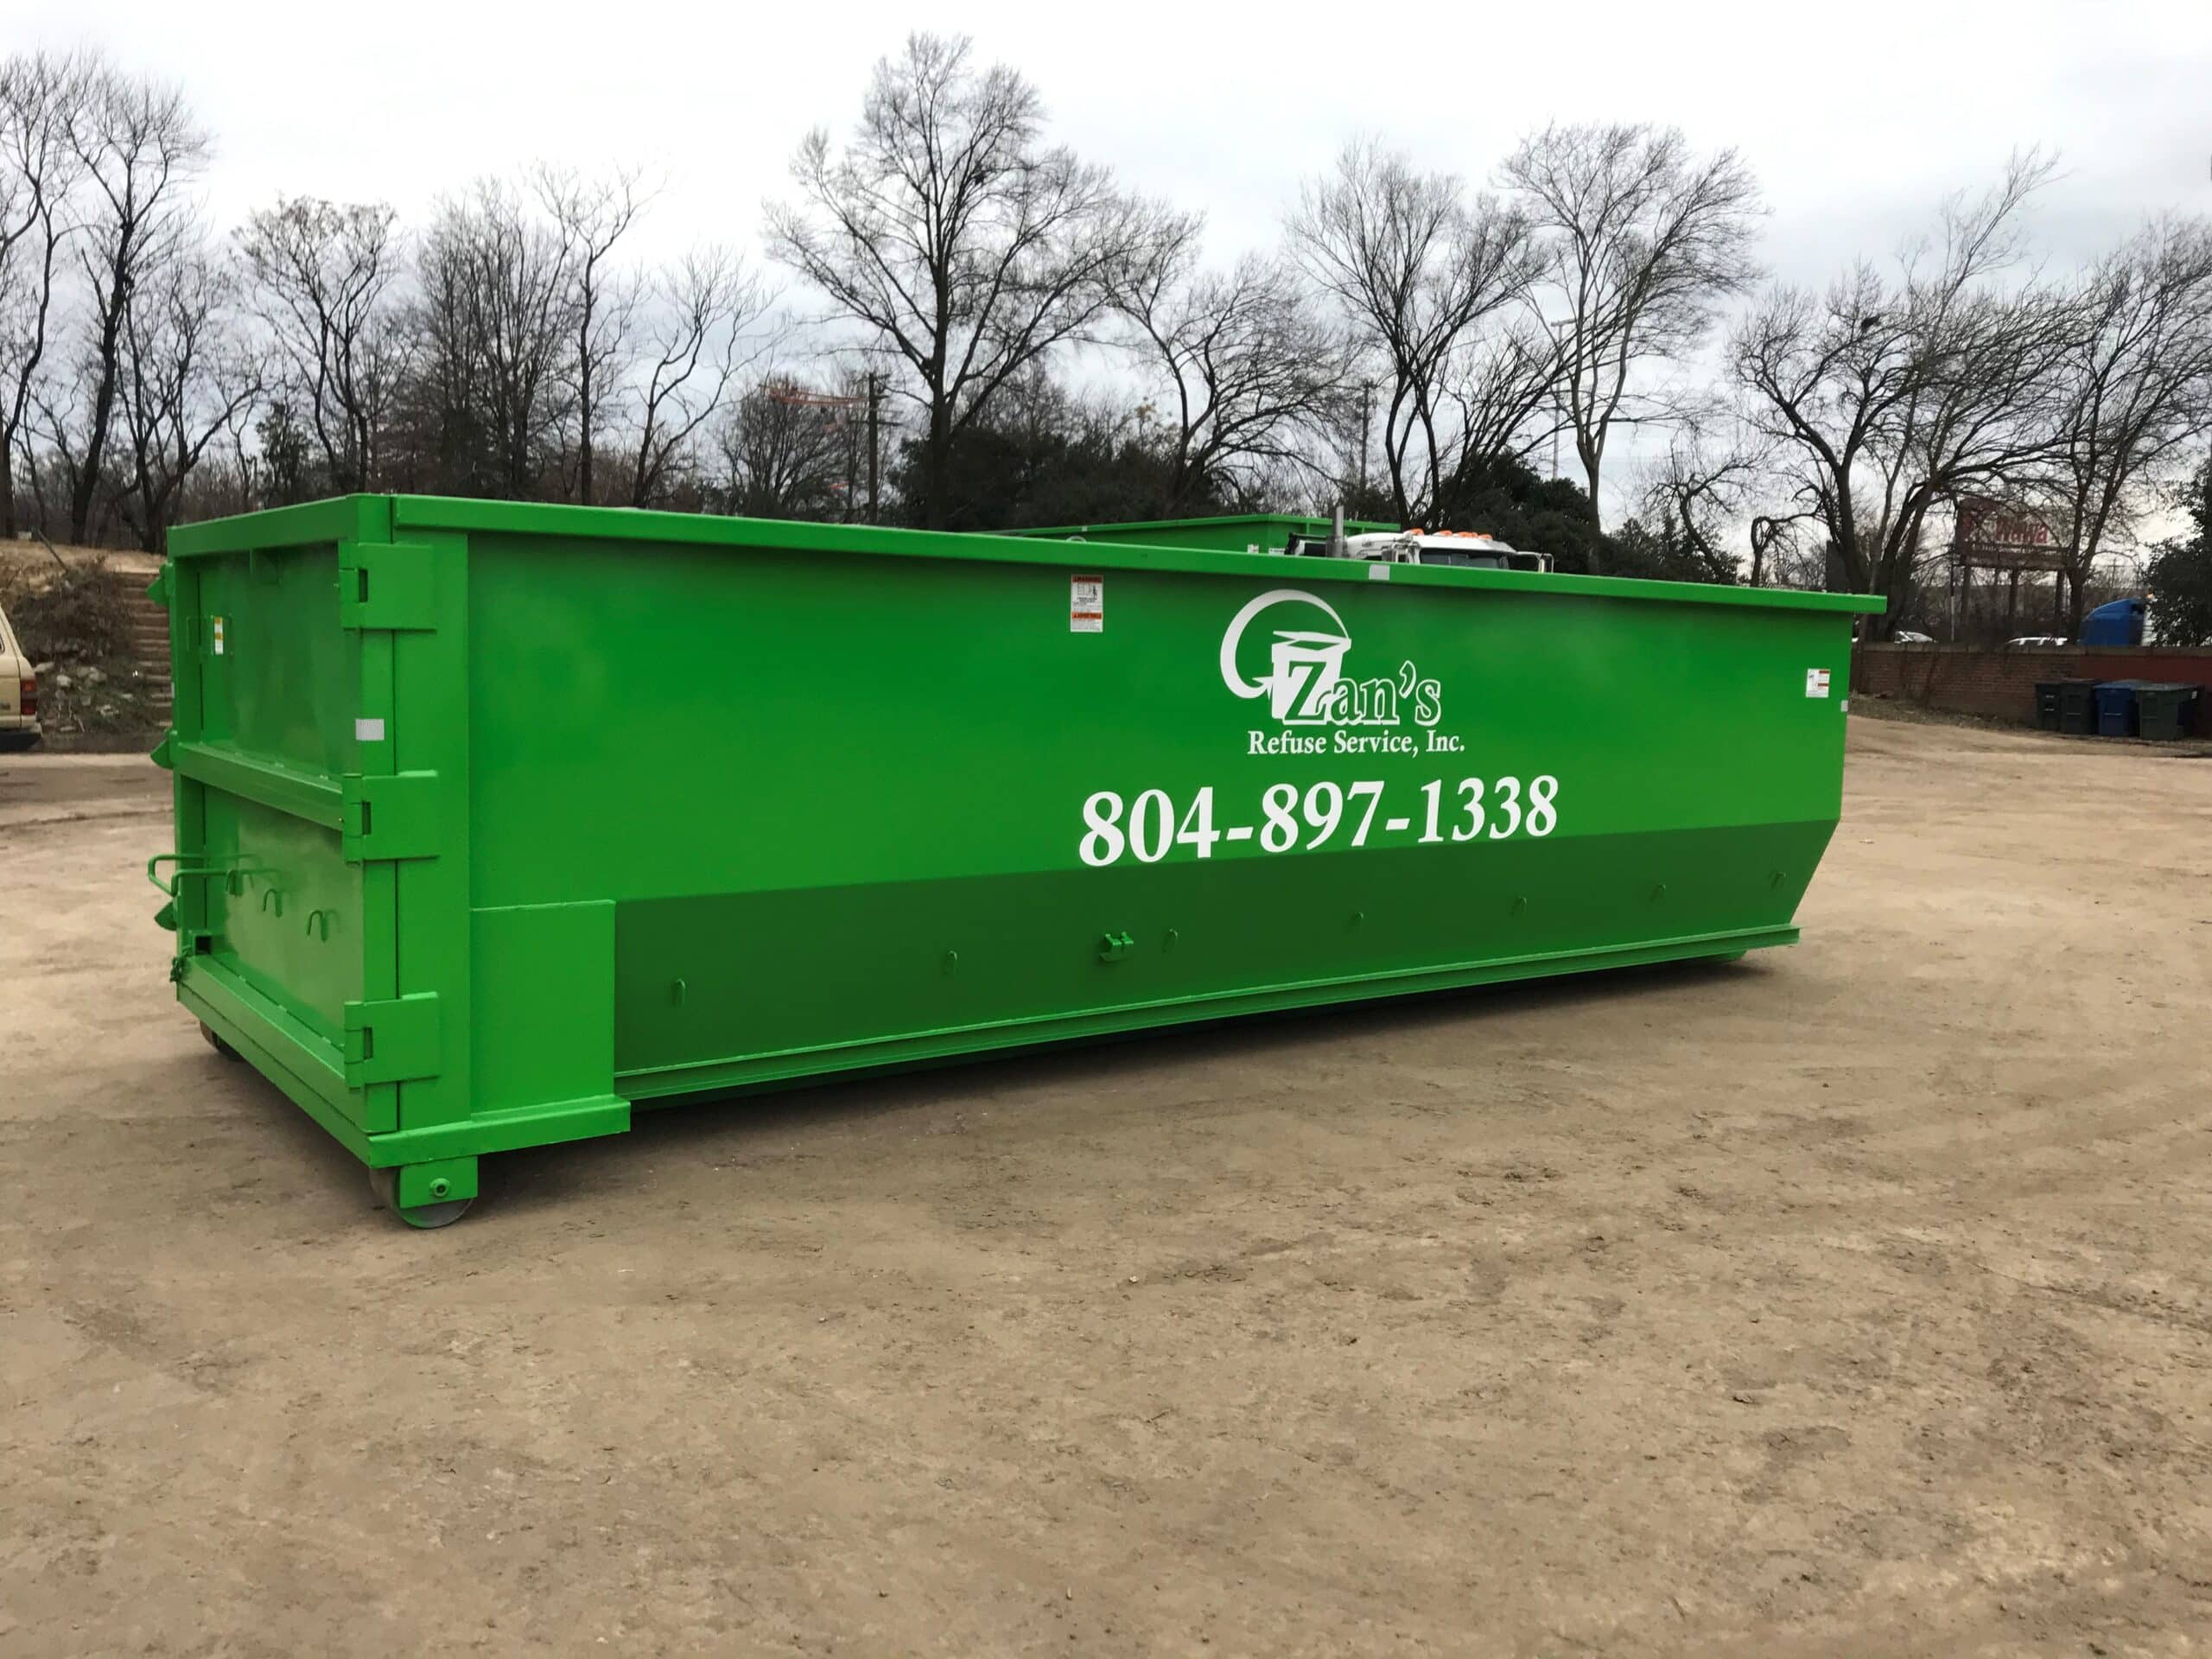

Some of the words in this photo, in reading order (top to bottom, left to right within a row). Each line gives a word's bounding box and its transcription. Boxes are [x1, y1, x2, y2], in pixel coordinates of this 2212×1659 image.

[1283, 660, 1442, 726] Zan's
[1247, 730, 1327, 754] Refuse
[1333, 729, 1419, 758] Service,
[1425, 729, 1465, 753] Inc.
[1078, 774, 1559, 868] 804-897-1338
